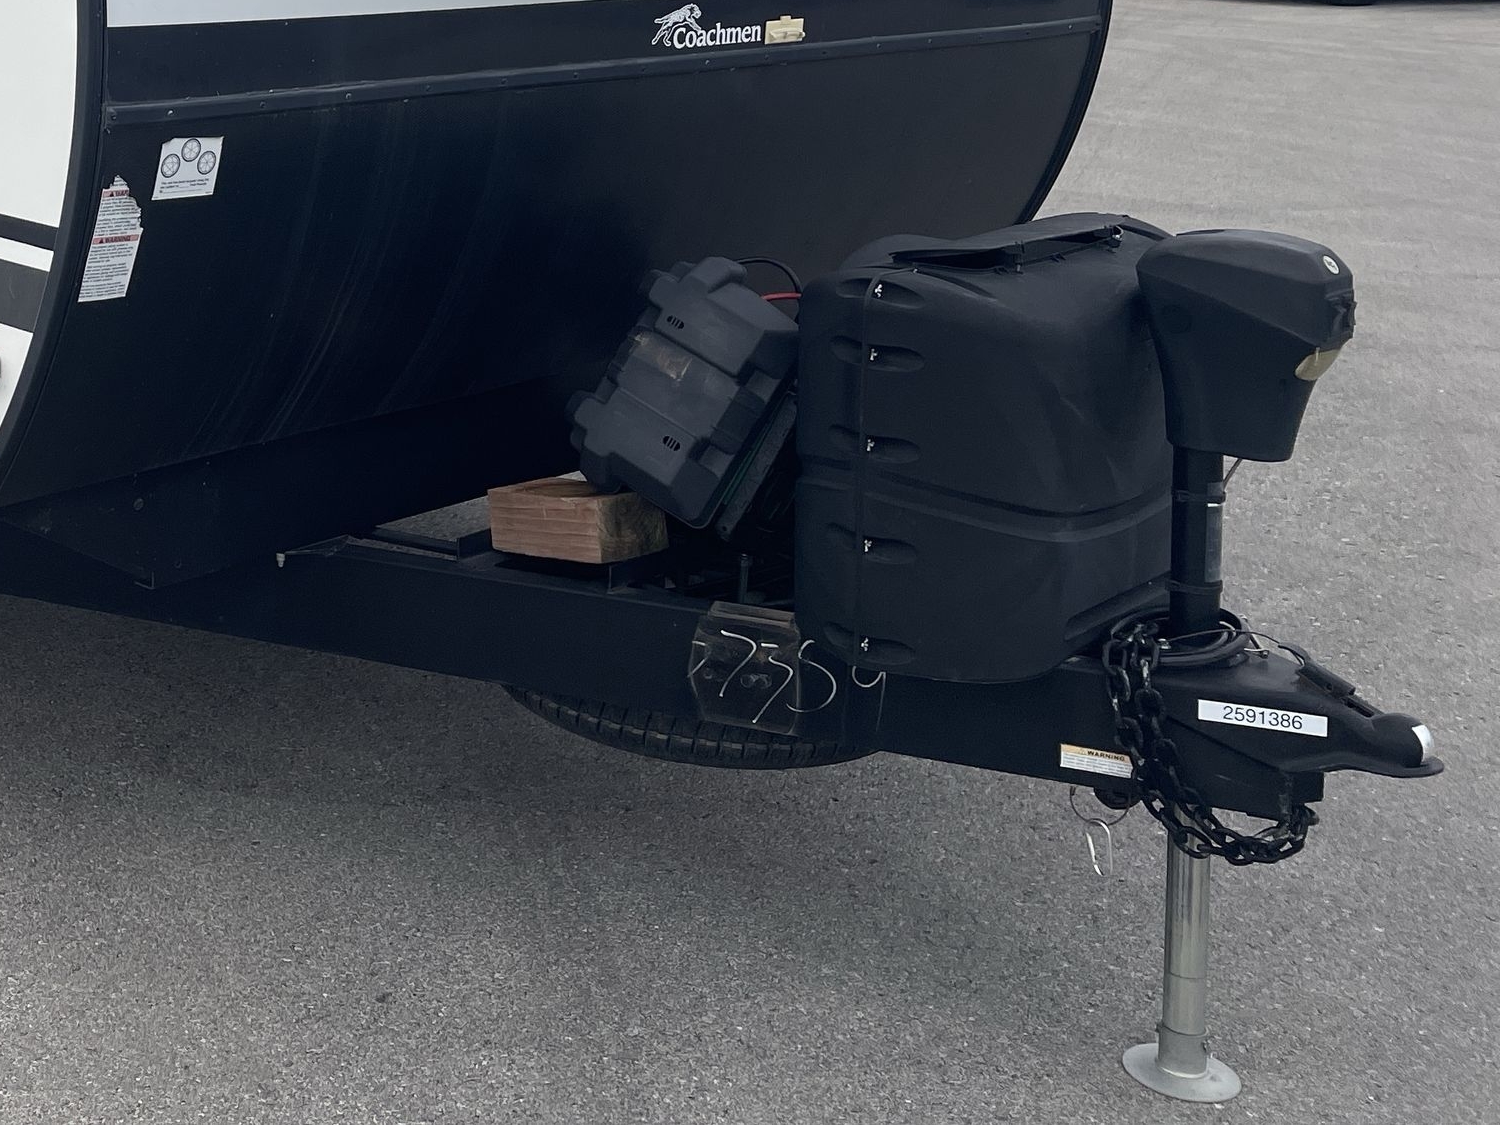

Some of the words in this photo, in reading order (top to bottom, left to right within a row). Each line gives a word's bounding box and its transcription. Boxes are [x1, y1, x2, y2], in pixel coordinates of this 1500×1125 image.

[672, 22, 761, 49] Coachmen
[1223, 706, 1303, 730] 2591386
[1087, 750, 1125, 761] WARNING
